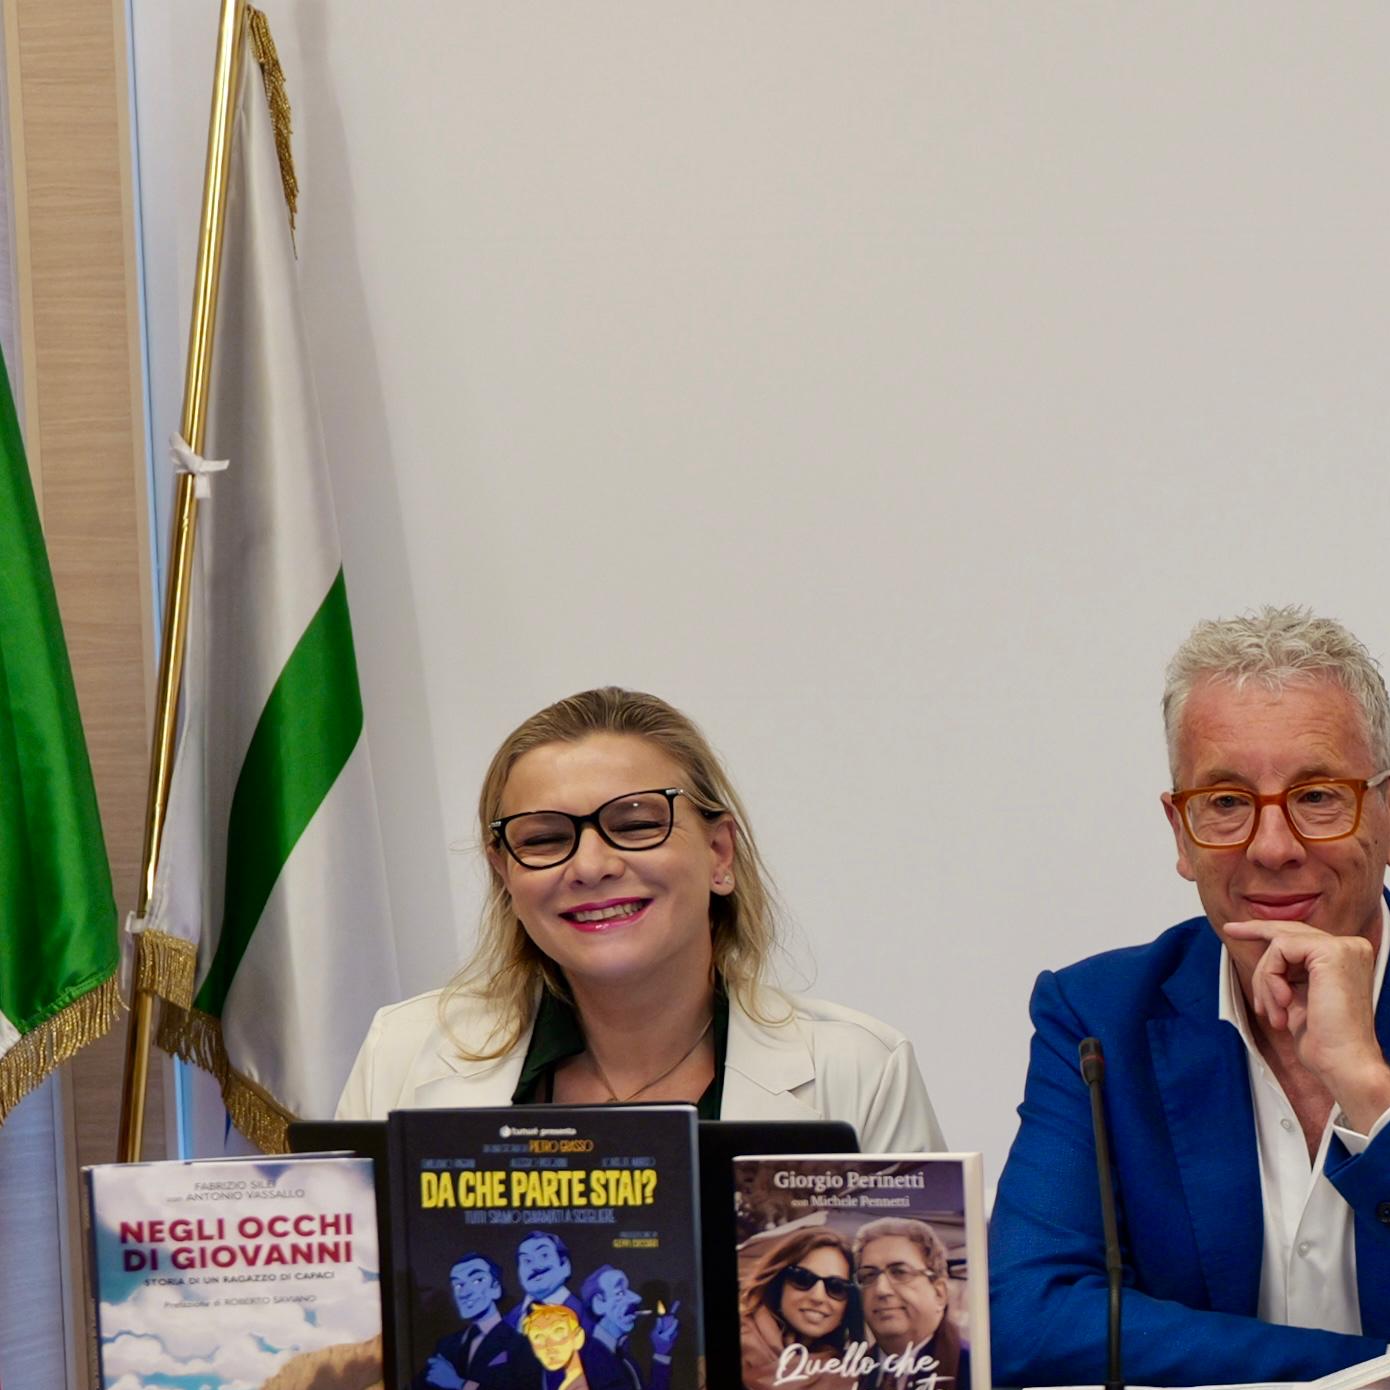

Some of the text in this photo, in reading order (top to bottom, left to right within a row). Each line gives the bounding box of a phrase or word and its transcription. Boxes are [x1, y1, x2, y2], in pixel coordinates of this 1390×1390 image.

[195, 1181, 246, 1191] FABRIZIO
[421, 1169, 657, 1208] DA CHE PARTE STAI?
[774, 1170, 925, 1193] Giorgio Perinetti
[186, 1189, 305, 1201] ANTONIO VASSALLO
[810, 1195, 858, 1207] Michele
[120, 1213, 354, 1244] NEGLI OCCHI
[122, 1241, 353, 1272] DI GIOVANNI
[144, 1271, 335, 1287] STORIA DI UN RAGAZZO DI CAPACI
[773, 1341, 939, 1383] Quello che
